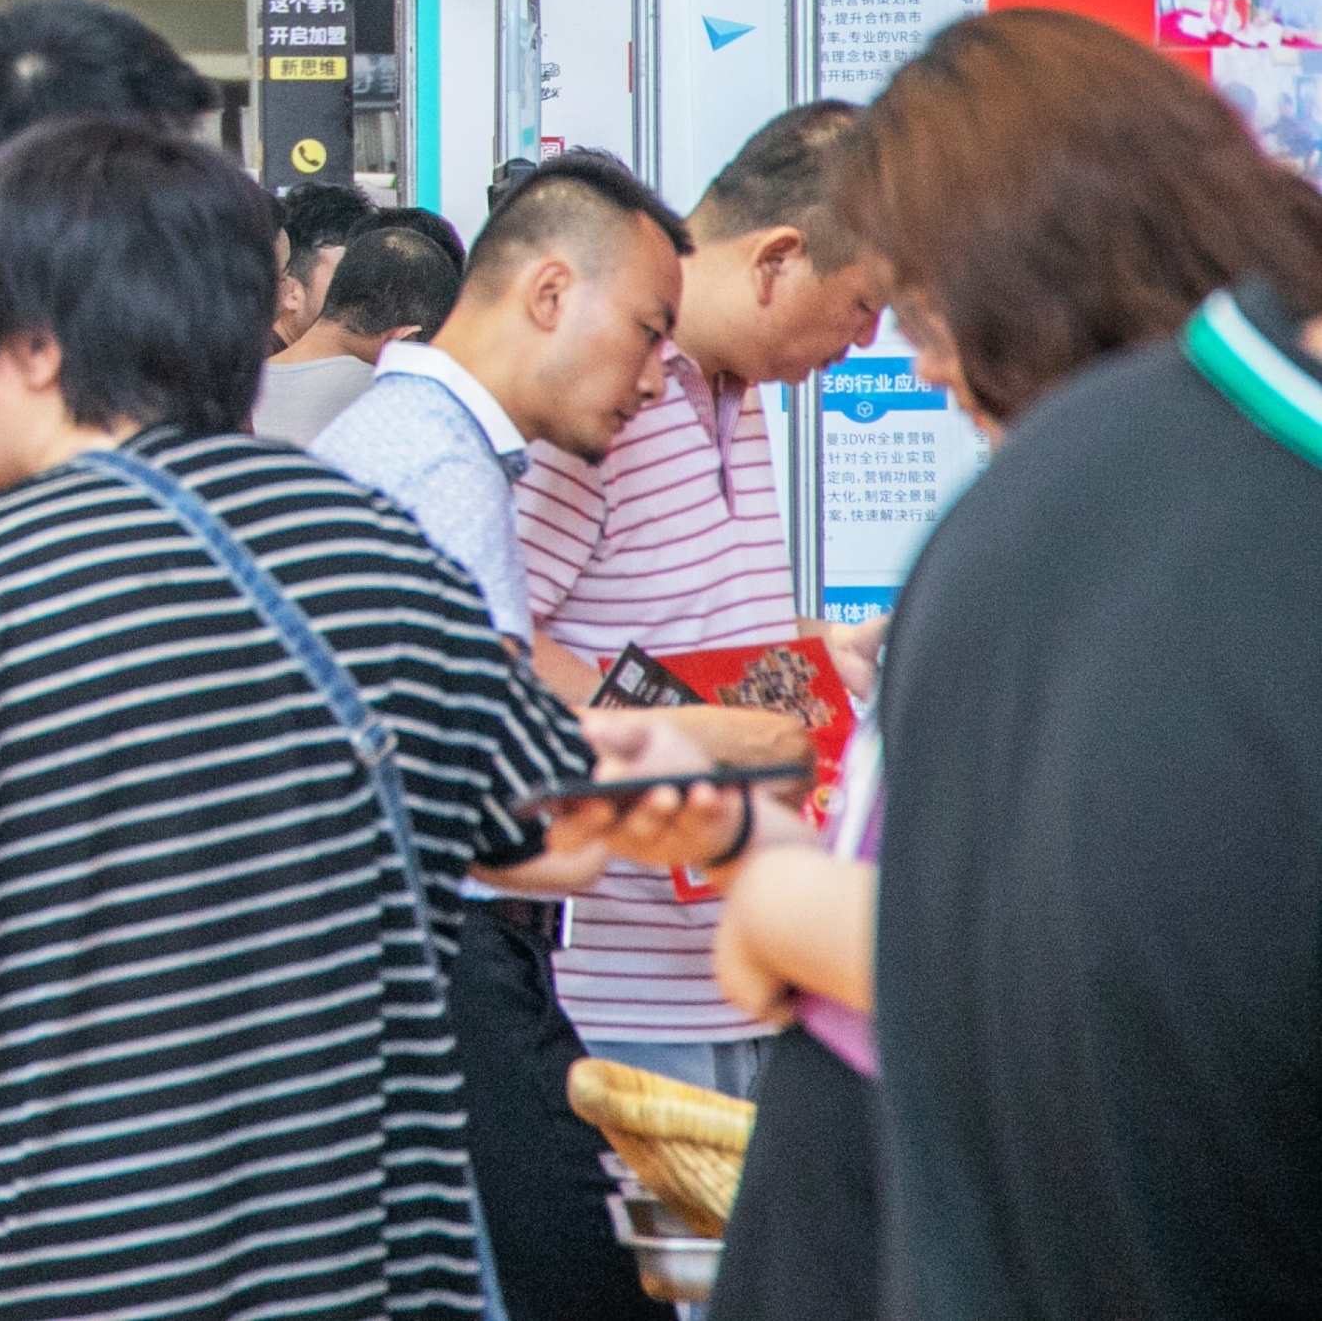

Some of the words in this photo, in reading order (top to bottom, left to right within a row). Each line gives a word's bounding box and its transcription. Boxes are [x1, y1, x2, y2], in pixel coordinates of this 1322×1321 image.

[269, 25, 347, 46] 开启加盟
[281, 60, 336, 77] 新思维
[823, 451, 936, 465] 针对全行业实现
[823, 471, 937, 484] 定向，营销功能效
[823, 490, 937, 504] 大化，制定全景展
[823, 509, 938, 523] 案，快速解决行业
[824, 603, 894, 621] 媒体植
